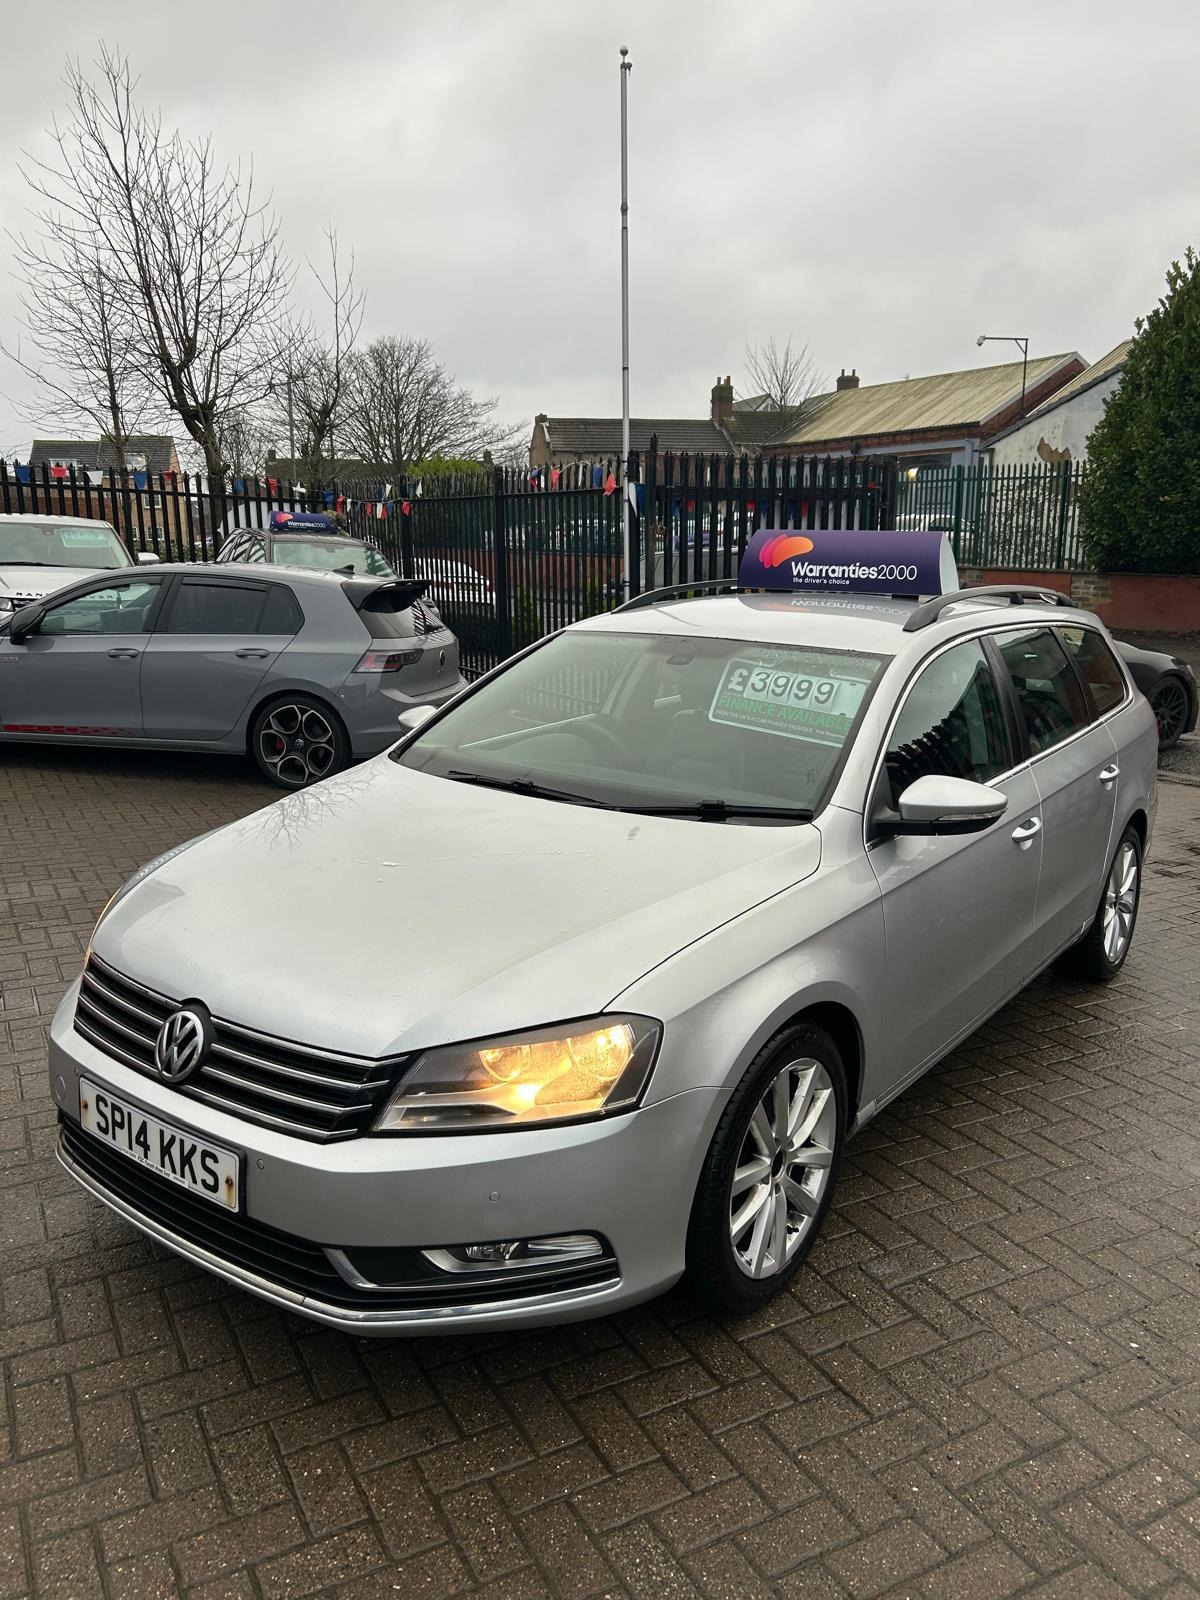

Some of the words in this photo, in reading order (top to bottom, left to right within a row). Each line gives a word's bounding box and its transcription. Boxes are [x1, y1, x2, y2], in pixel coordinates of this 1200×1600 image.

[791, 561, 917, 581] Warranties2000
[716, 710, 730, 718] FROM
[767, 719, 789, 728] FINANCE
[788, 723, 813, 733] PROVIDER
[718, 695, 776, 717] FINANCE
[777, 707, 851, 732] AVAILABLE
[95, 1093, 151, 1160] SP14
[159, 1128, 220, 1194] KKS
